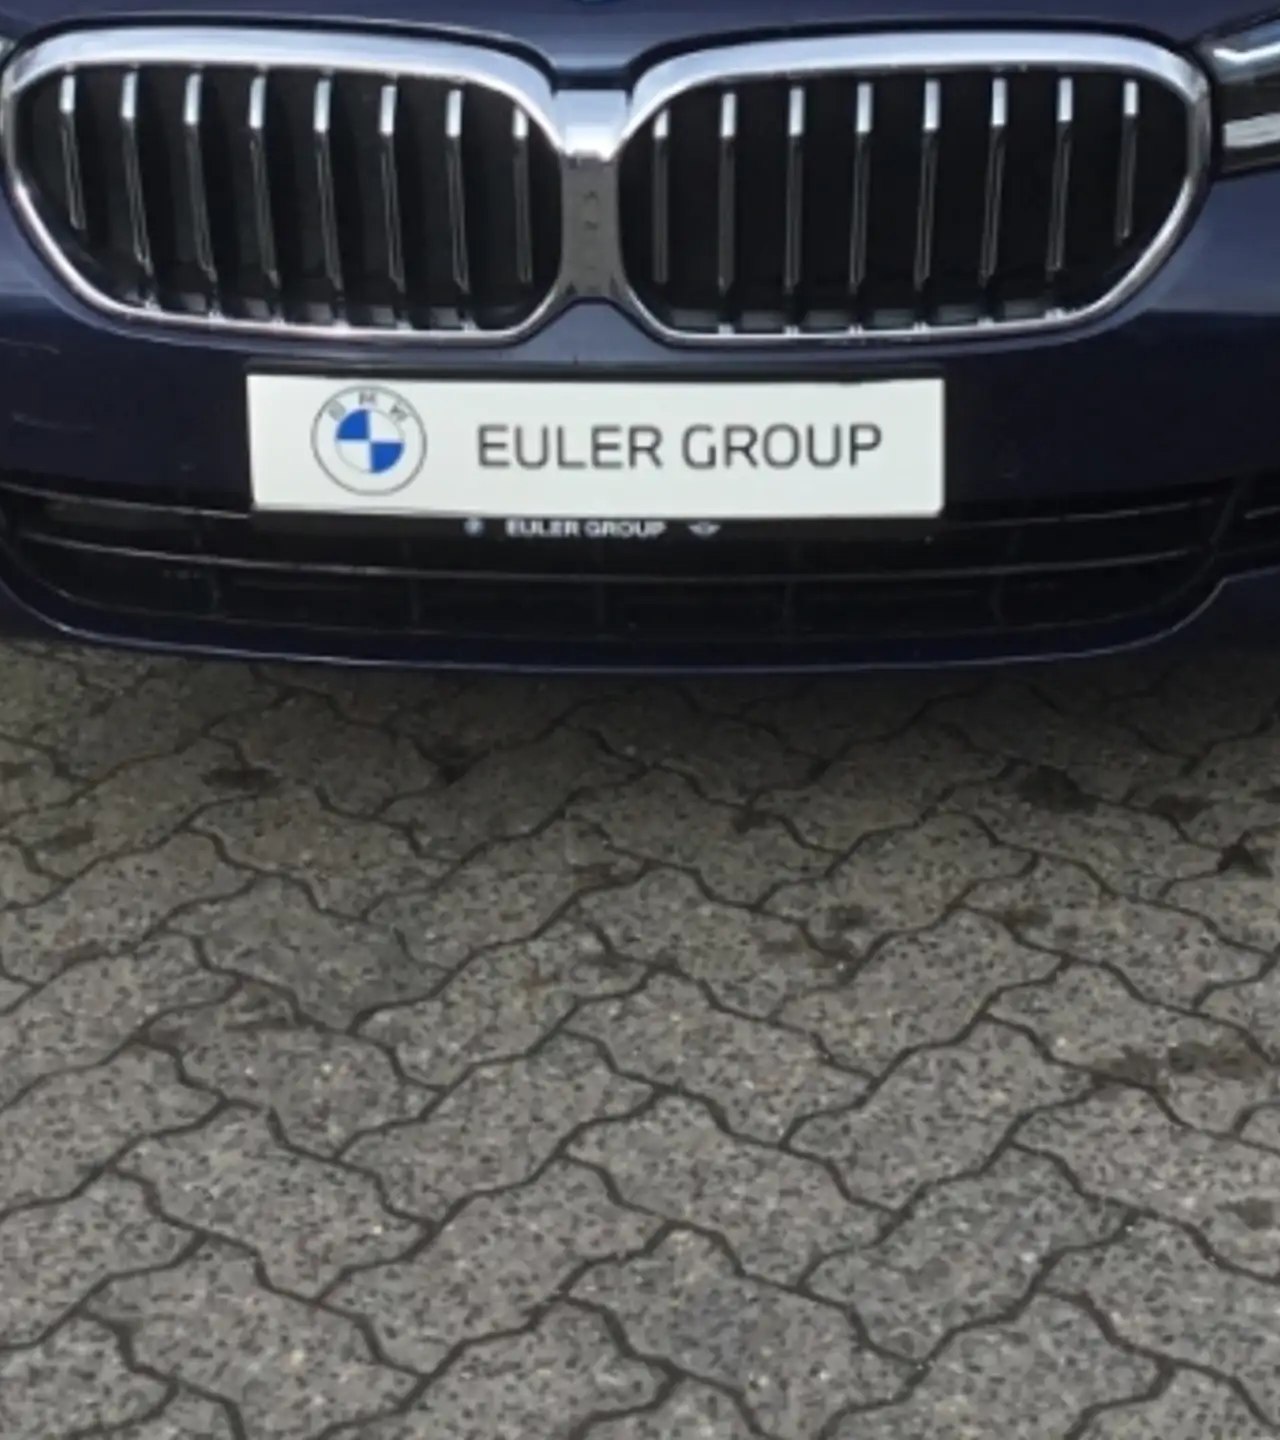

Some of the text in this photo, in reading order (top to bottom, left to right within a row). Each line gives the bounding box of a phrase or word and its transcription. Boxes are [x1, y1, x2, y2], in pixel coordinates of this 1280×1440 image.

[477, 421, 883, 470] EULER GROUP
[505, 517, 667, 539] EULER GROUP
